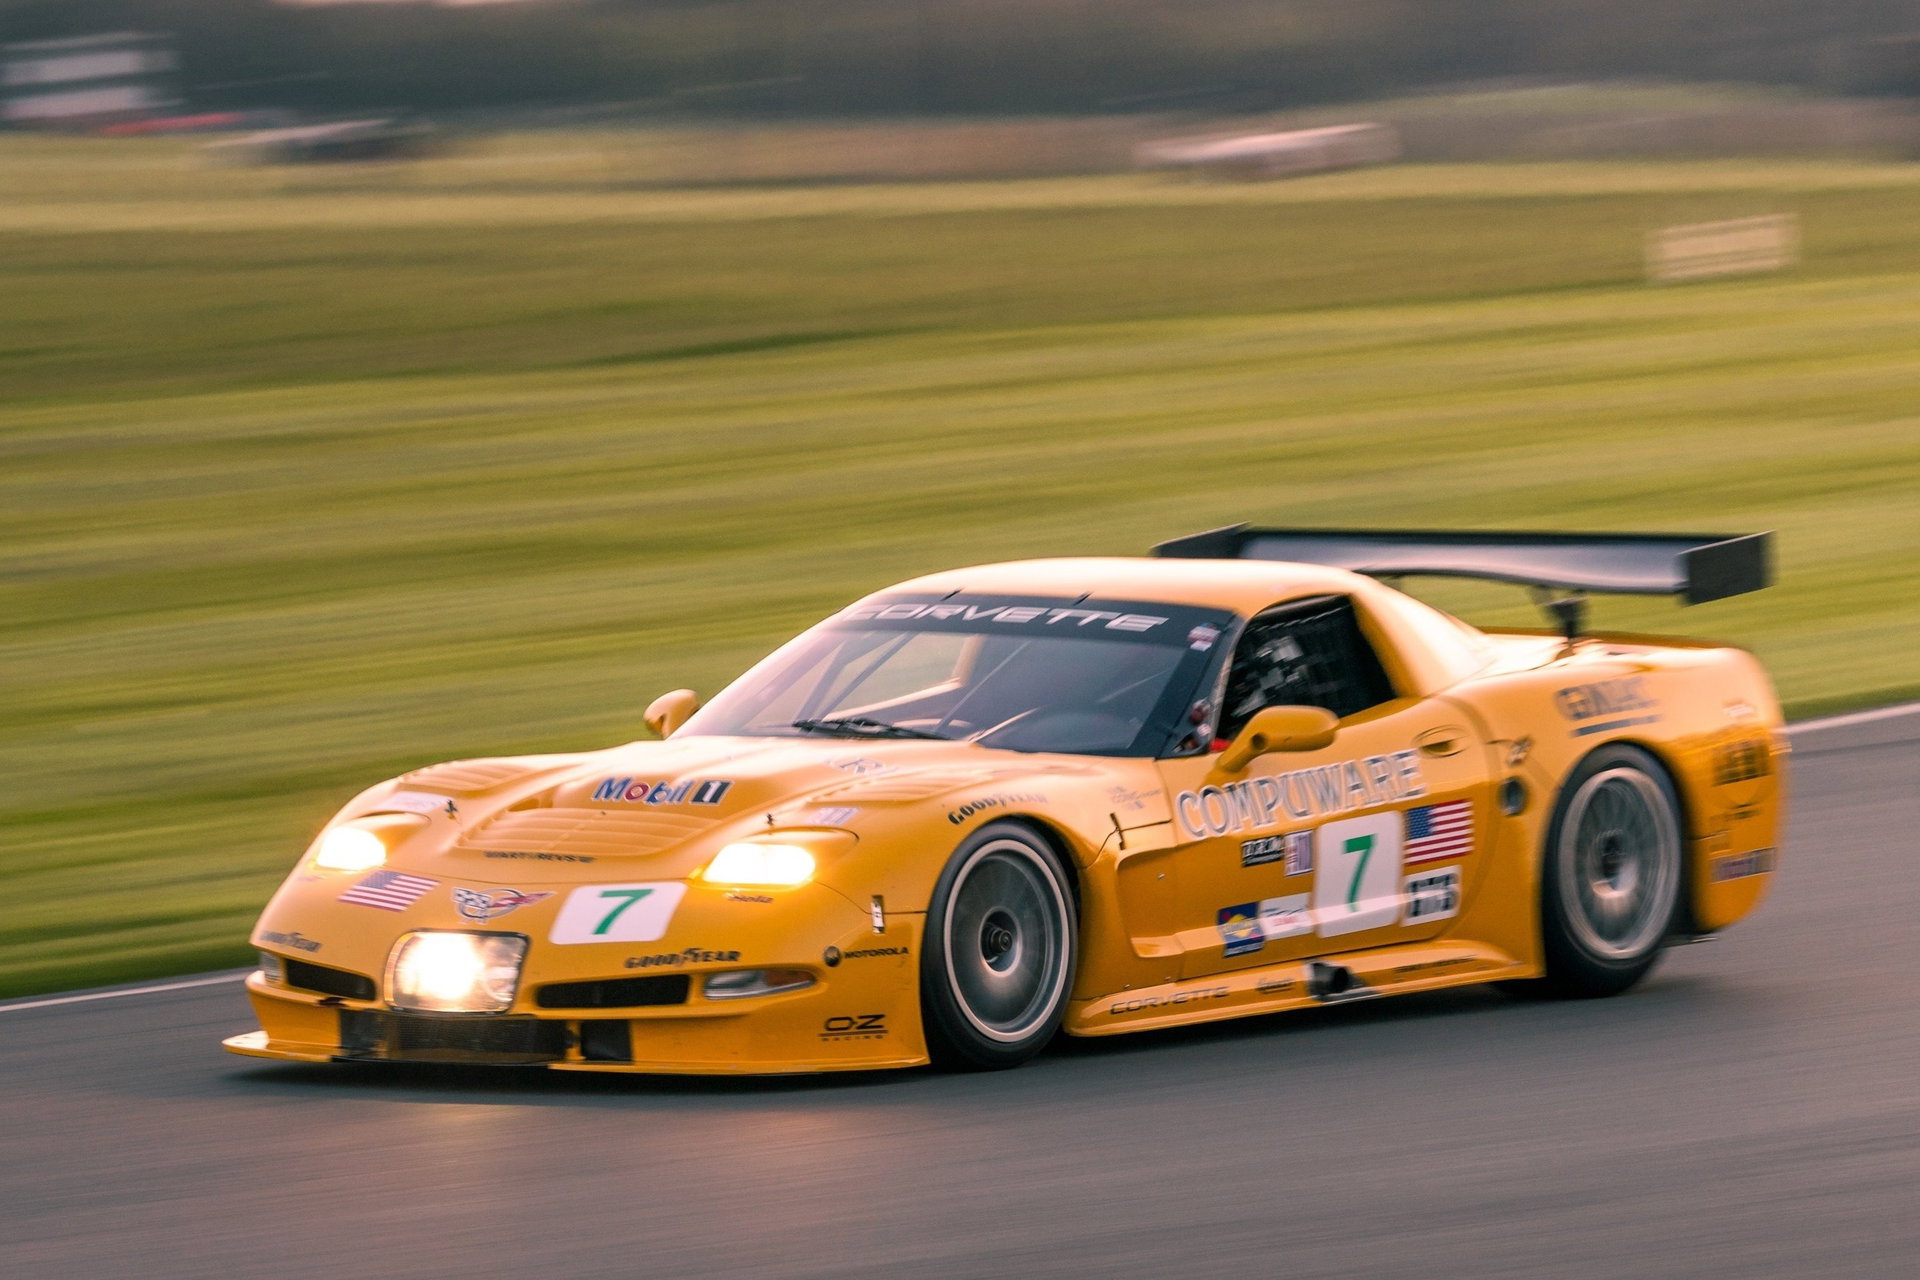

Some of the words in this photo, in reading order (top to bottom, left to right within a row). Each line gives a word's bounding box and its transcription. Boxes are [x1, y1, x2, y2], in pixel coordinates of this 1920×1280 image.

[844, 603, 1170, 632] CORVETTE
[591, 777, 695, 806] Mobil
[1177, 749, 1428, 840] COMPUWARE
[1341, 833, 1378, 912] 7
[592, 889, 654, 936] 7
[624, 947, 742, 969] GOODYEAR
[844, 946, 909, 959] MOTOROLA
[1110, 986, 1230, 1015] CORVETTE
